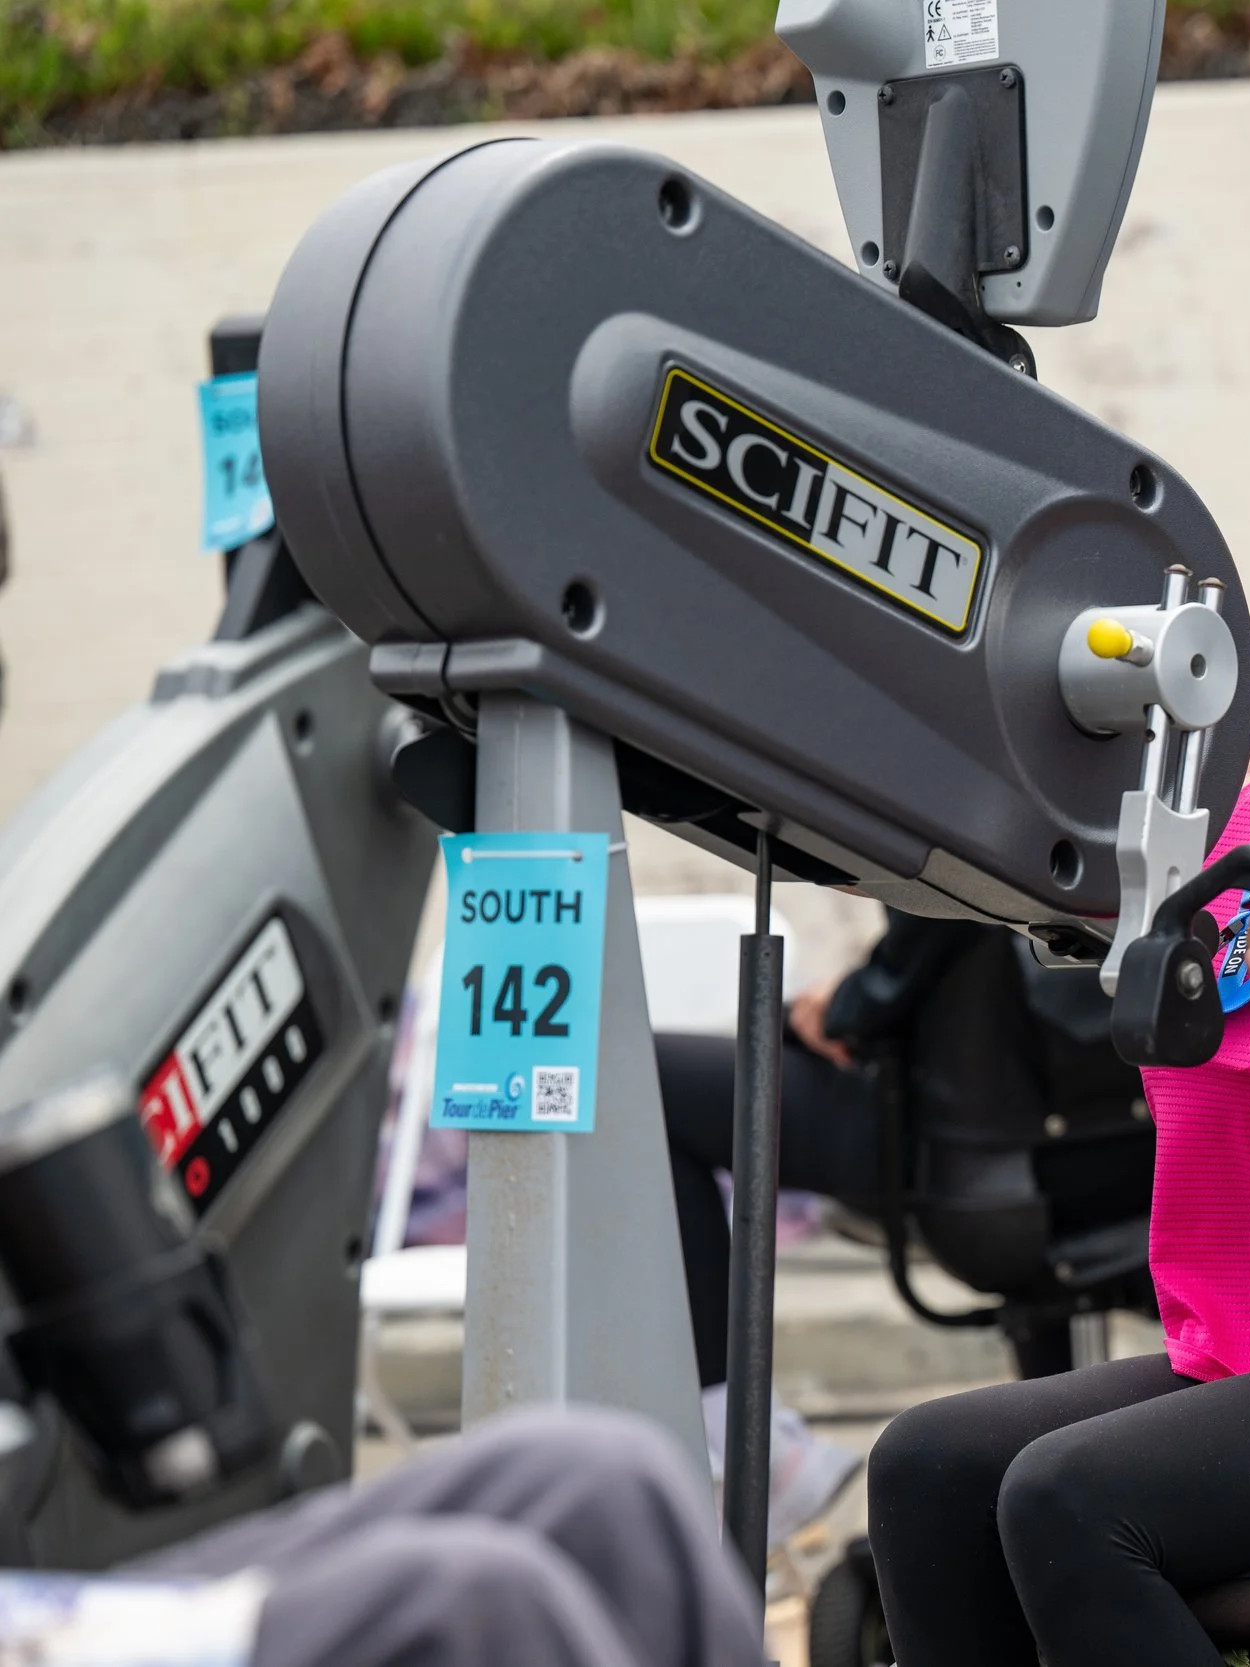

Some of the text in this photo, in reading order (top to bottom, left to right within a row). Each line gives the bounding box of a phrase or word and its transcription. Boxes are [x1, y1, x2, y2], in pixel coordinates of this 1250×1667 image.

[670, 400, 961, 601] SCIFIT
[461, 890, 583, 924] SOUTH
[462, 964, 571, 1037] 142
[1223, 956, 1243, 975] ON
[141, 945, 278, 1165] CIFIT
